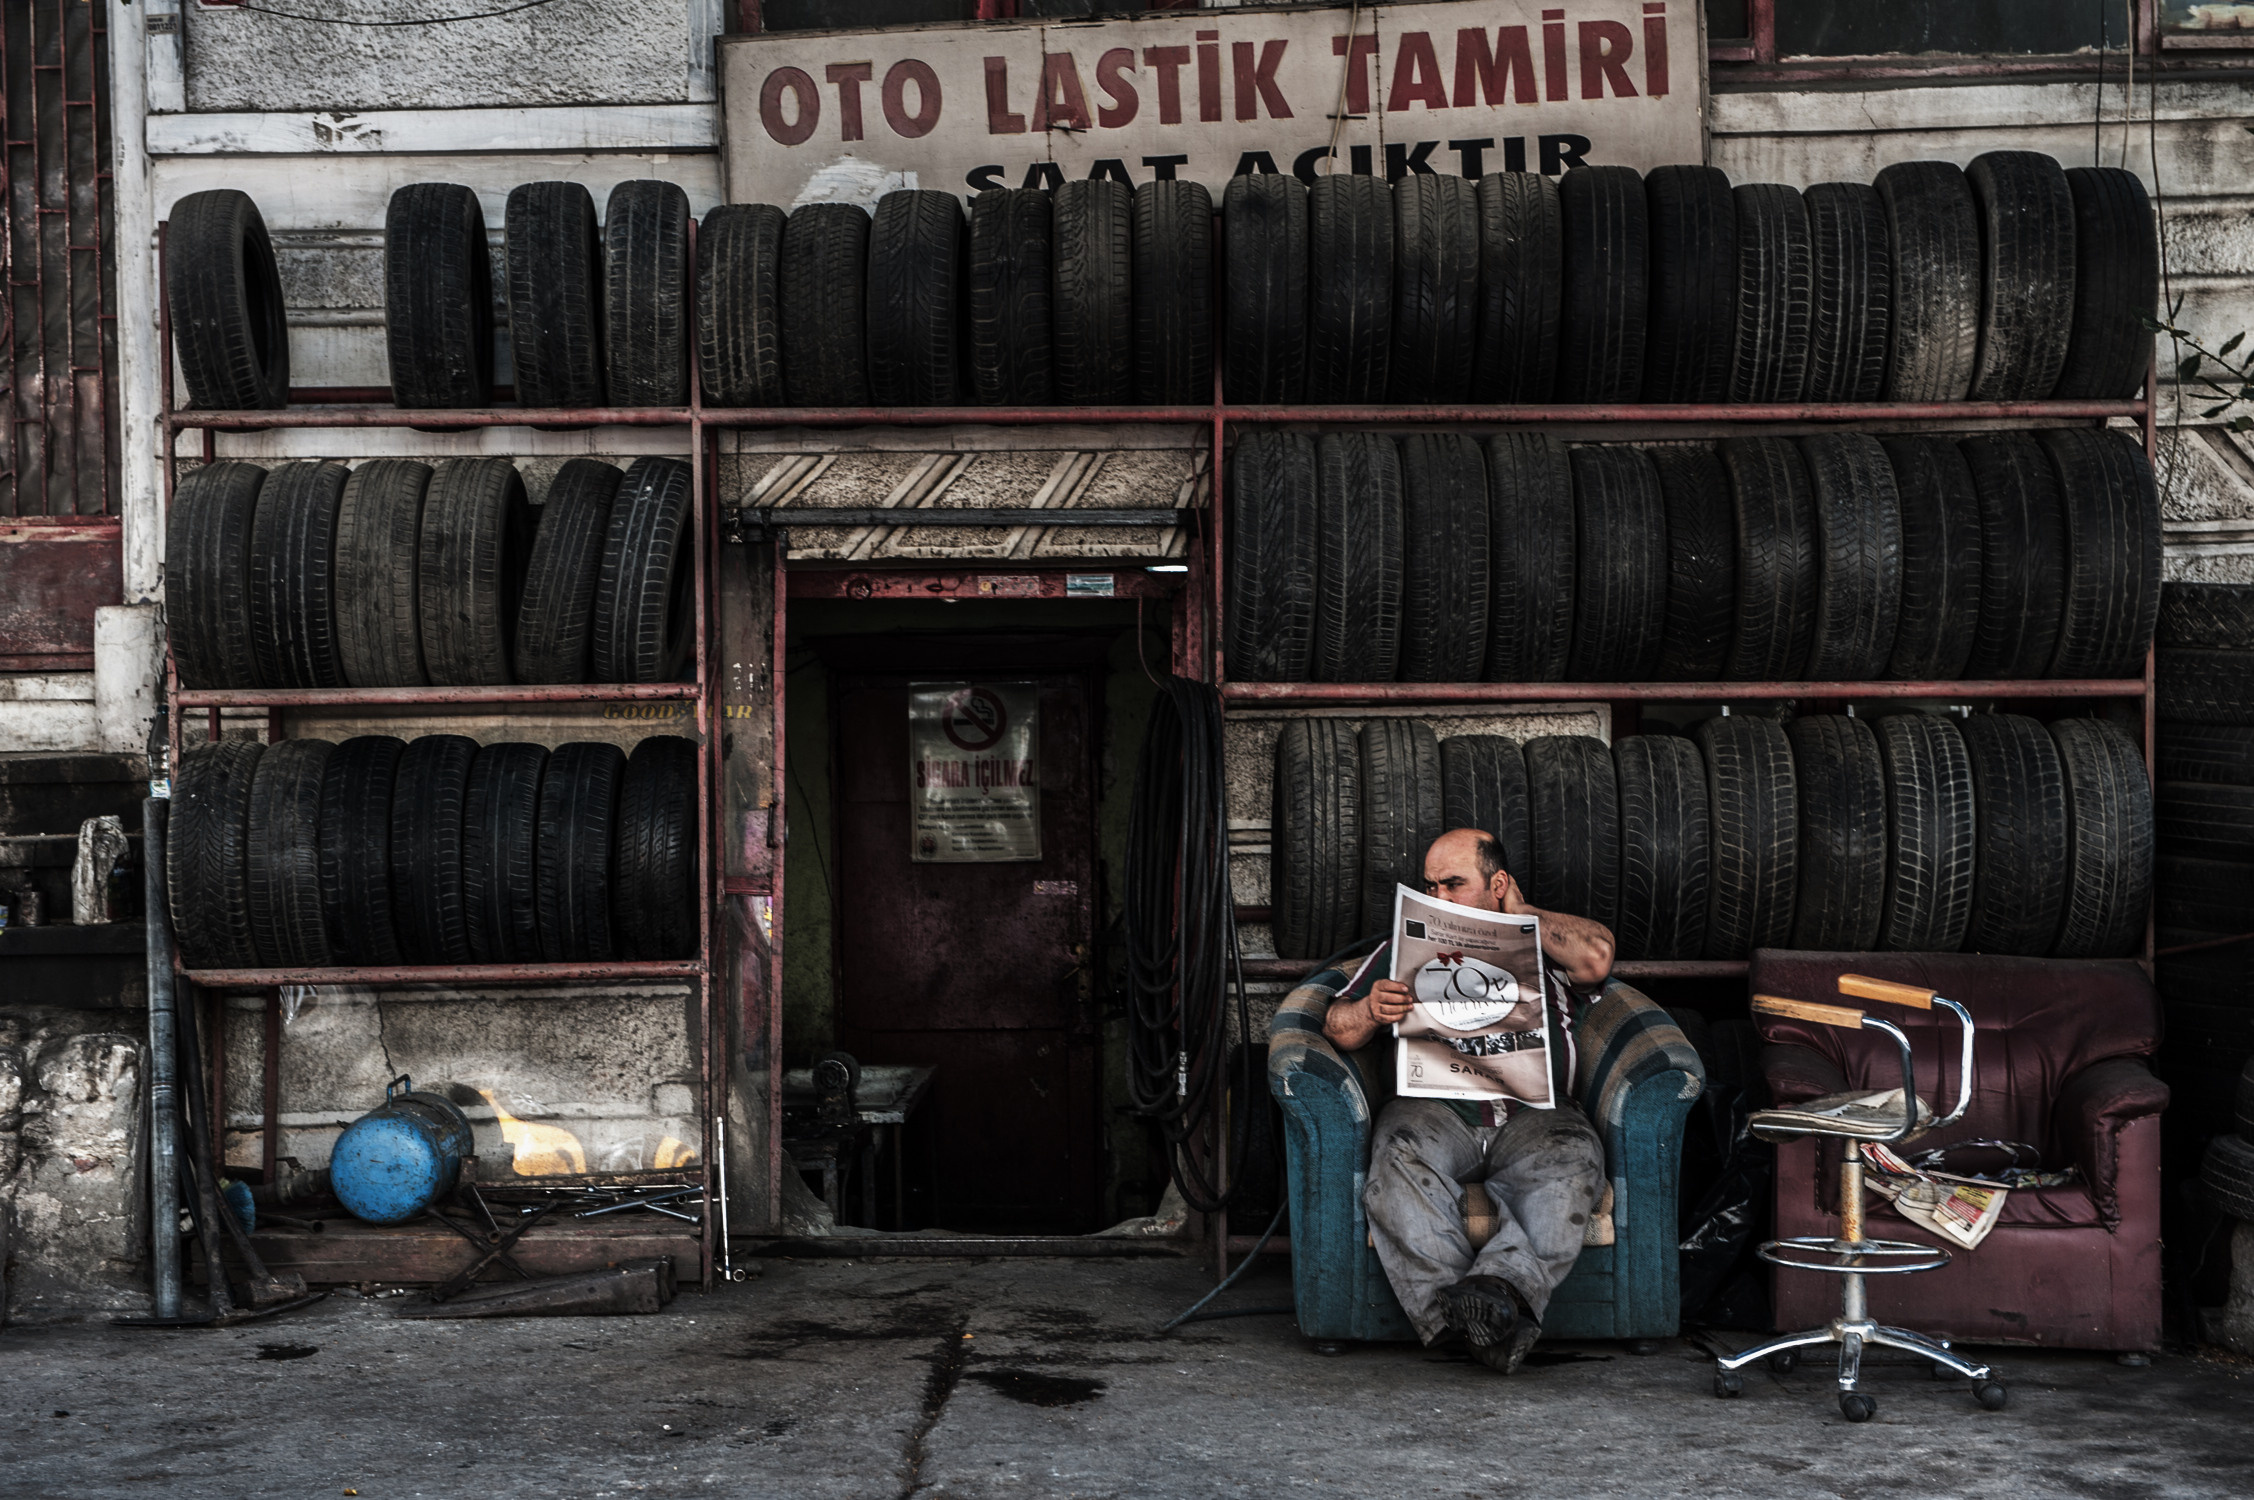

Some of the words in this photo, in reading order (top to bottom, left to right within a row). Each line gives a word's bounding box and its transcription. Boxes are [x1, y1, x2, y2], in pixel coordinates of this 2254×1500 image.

[759, 58, 942, 147] OTO
[983, 30, 1295, 136] LASTİK
[1332, 2, 1670, 115] TAMİRİ
[917, 755, 970, 788] SİGARA
